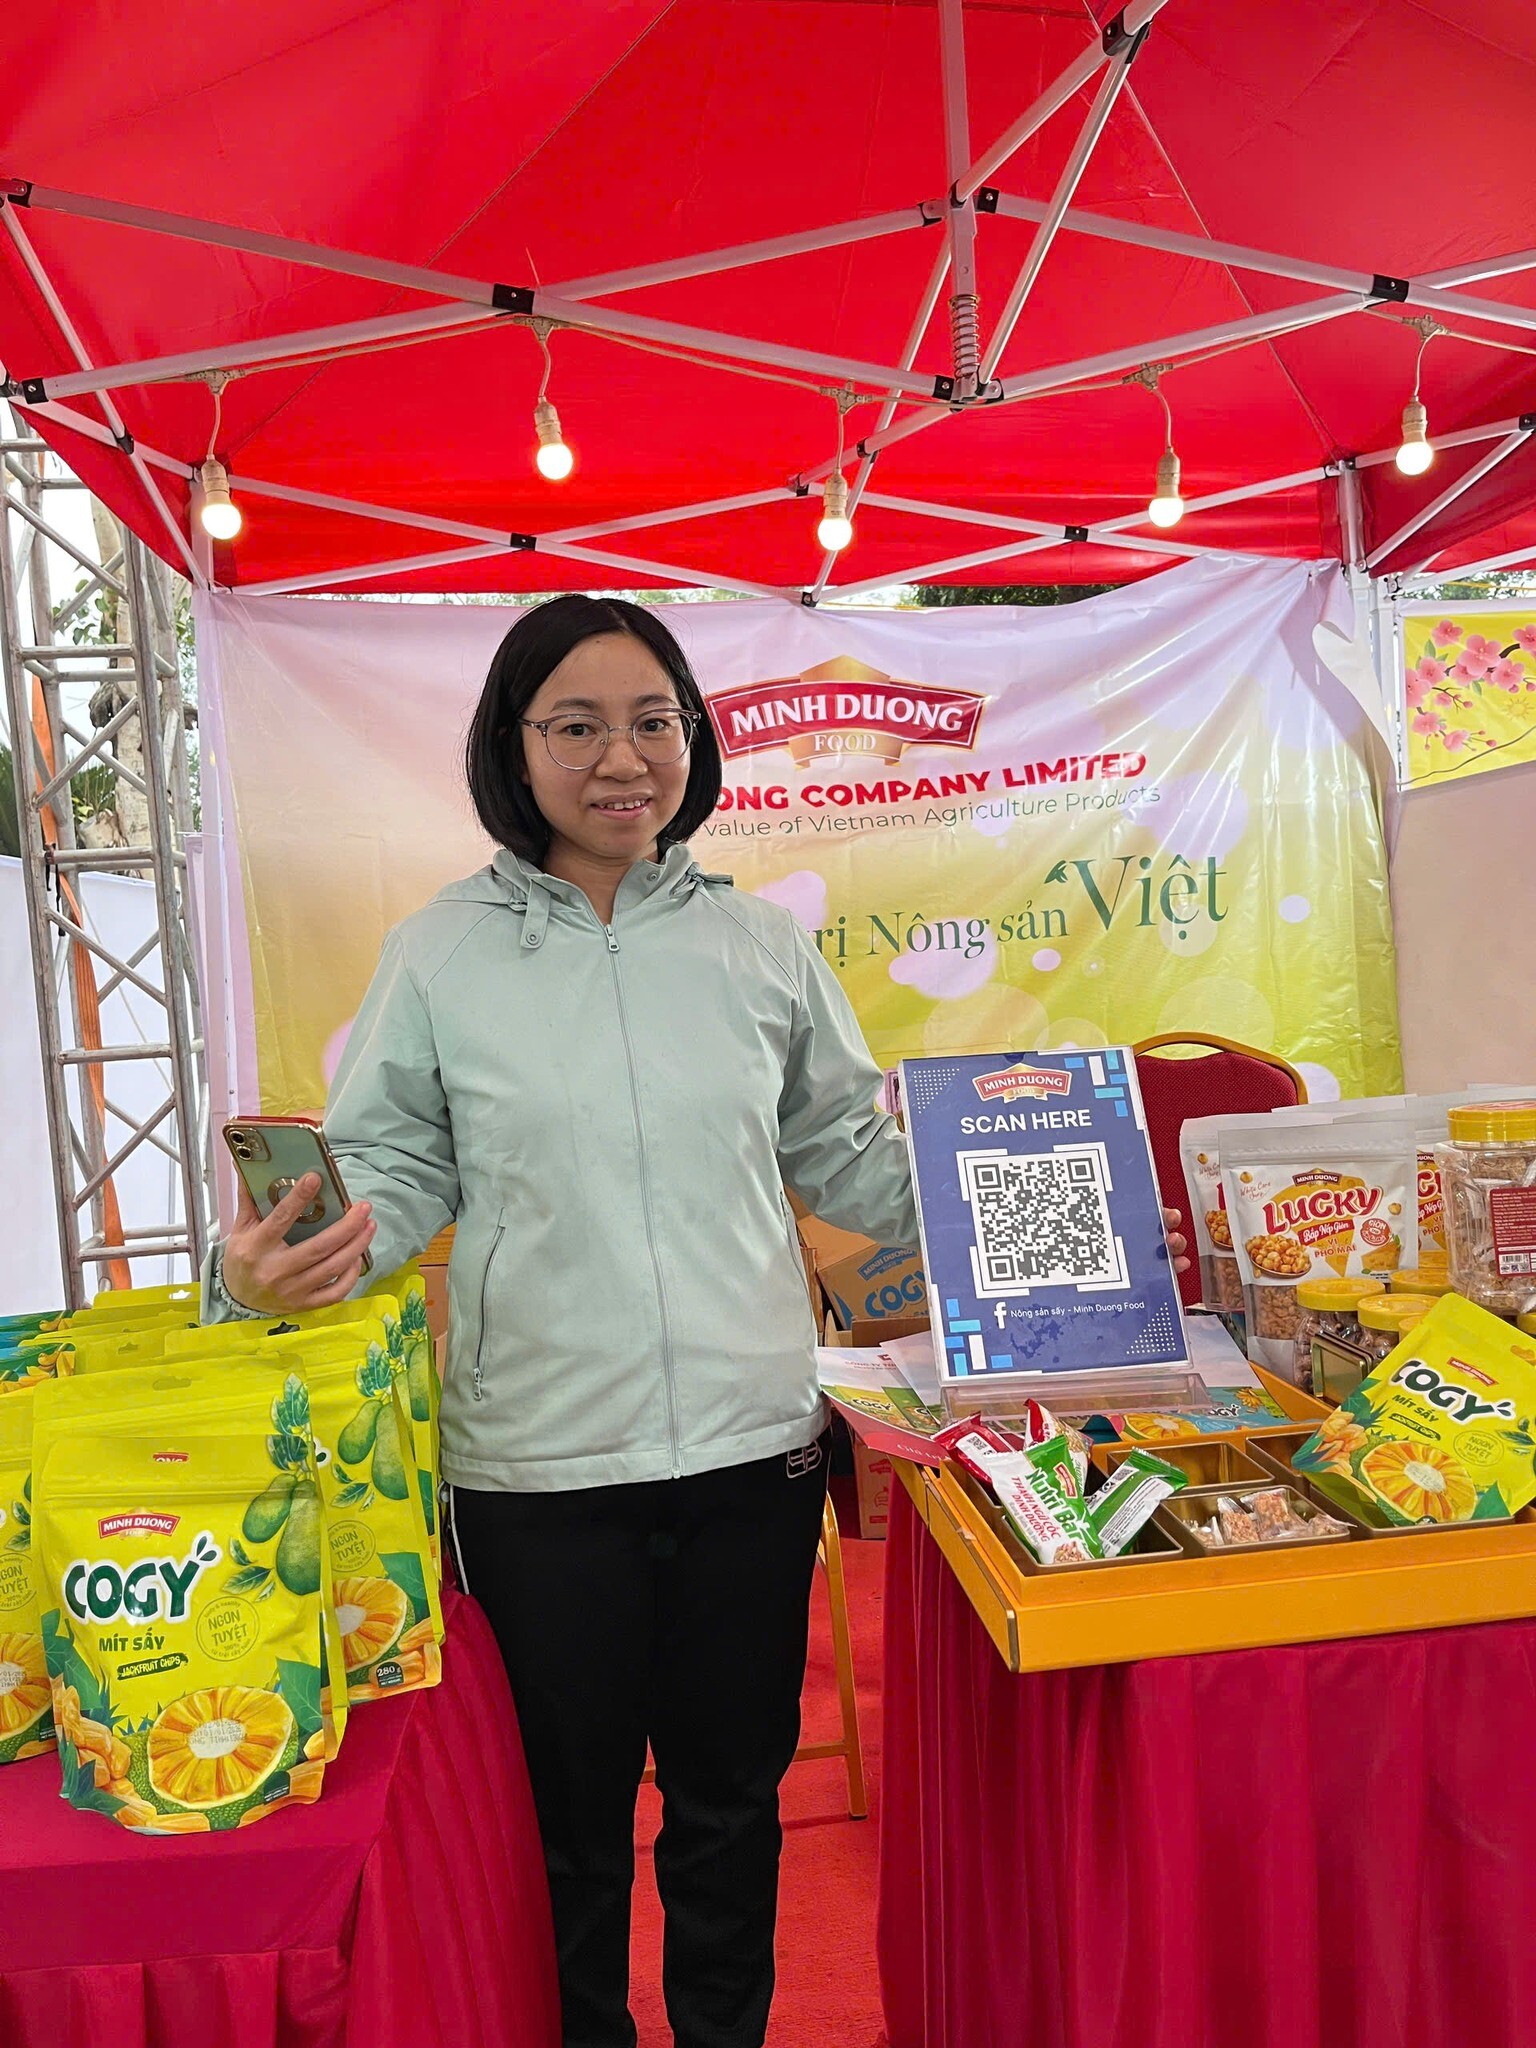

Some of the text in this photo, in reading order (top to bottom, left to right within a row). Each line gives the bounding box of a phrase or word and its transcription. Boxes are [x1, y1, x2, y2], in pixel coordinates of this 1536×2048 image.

[730, 692, 964, 738] MINH DUONG
[813, 732, 876, 752] FOOD
[800, 771, 991, 808] COMPANY
[1003, 752, 1147, 788] LIMITED
[779, 816, 802, 834] of
[808, 812, 916, 833] Vietnam
[924, 795, 1057, 827] Agriculture
[1066, 784, 1161, 811] Products
[807, 854, 1229, 967] rị Nông sản Việt
[983, 1075, 1063, 1092] MINH DUONG
[960, 1109, 1092, 1134] SCAN HERE
[1262, 1186, 1382, 1235] LUCKY
[1010, 1309, 1033, 1319] Nông
[1073, 1304, 1093, 1313] Minh
[1096, 1303, 1122, 1312] Duong
[1124, 1301, 1145, 1310] Food
[1391, 1360, 1495, 1422] COGY
[1392, 1393, 1416, 1409] MÍT
[1025, 1467, 1082, 1540] Nutri Bar
[103, 1517, 173, 1532] MINH DUONG
[330, 1530, 358, 1550] NGON
[0, 1565, 22, 1580] GON
[65, 1559, 200, 1619] COGY
[207, 1609, 241, 1631] NGON
[98, 1626, 165, 1652] MÍT SẤY
[121, 1659, 159, 1677] JACKFRUIT
[377, 1665, 396, 1677] 280
